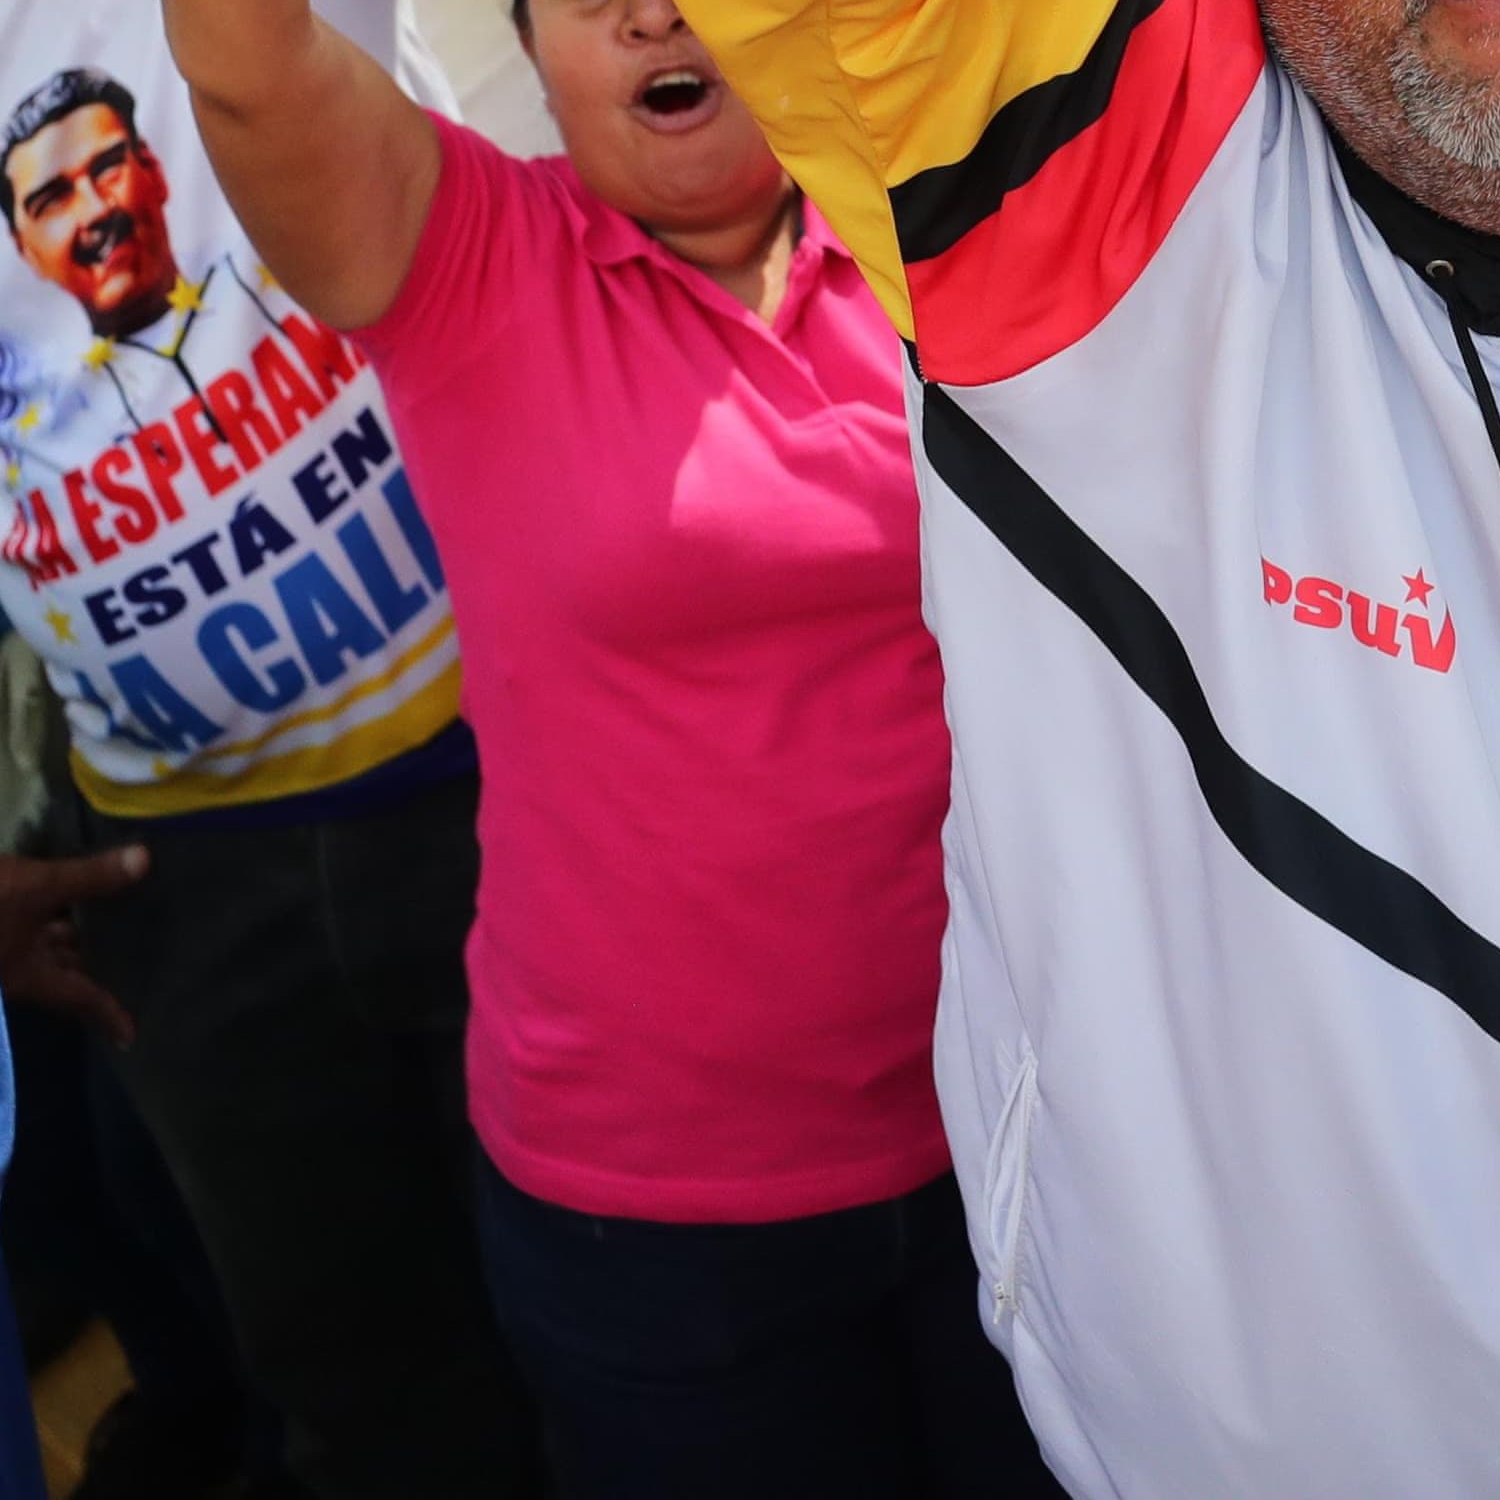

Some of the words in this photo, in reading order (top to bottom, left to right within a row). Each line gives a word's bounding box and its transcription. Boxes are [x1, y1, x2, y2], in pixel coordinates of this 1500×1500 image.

[62, 312, 369, 565] ESPERAN
[84, 492, 297, 647] ESTÁ
[292, 406, 393, 525] EN
[195, 464, 446, 715] CALL
